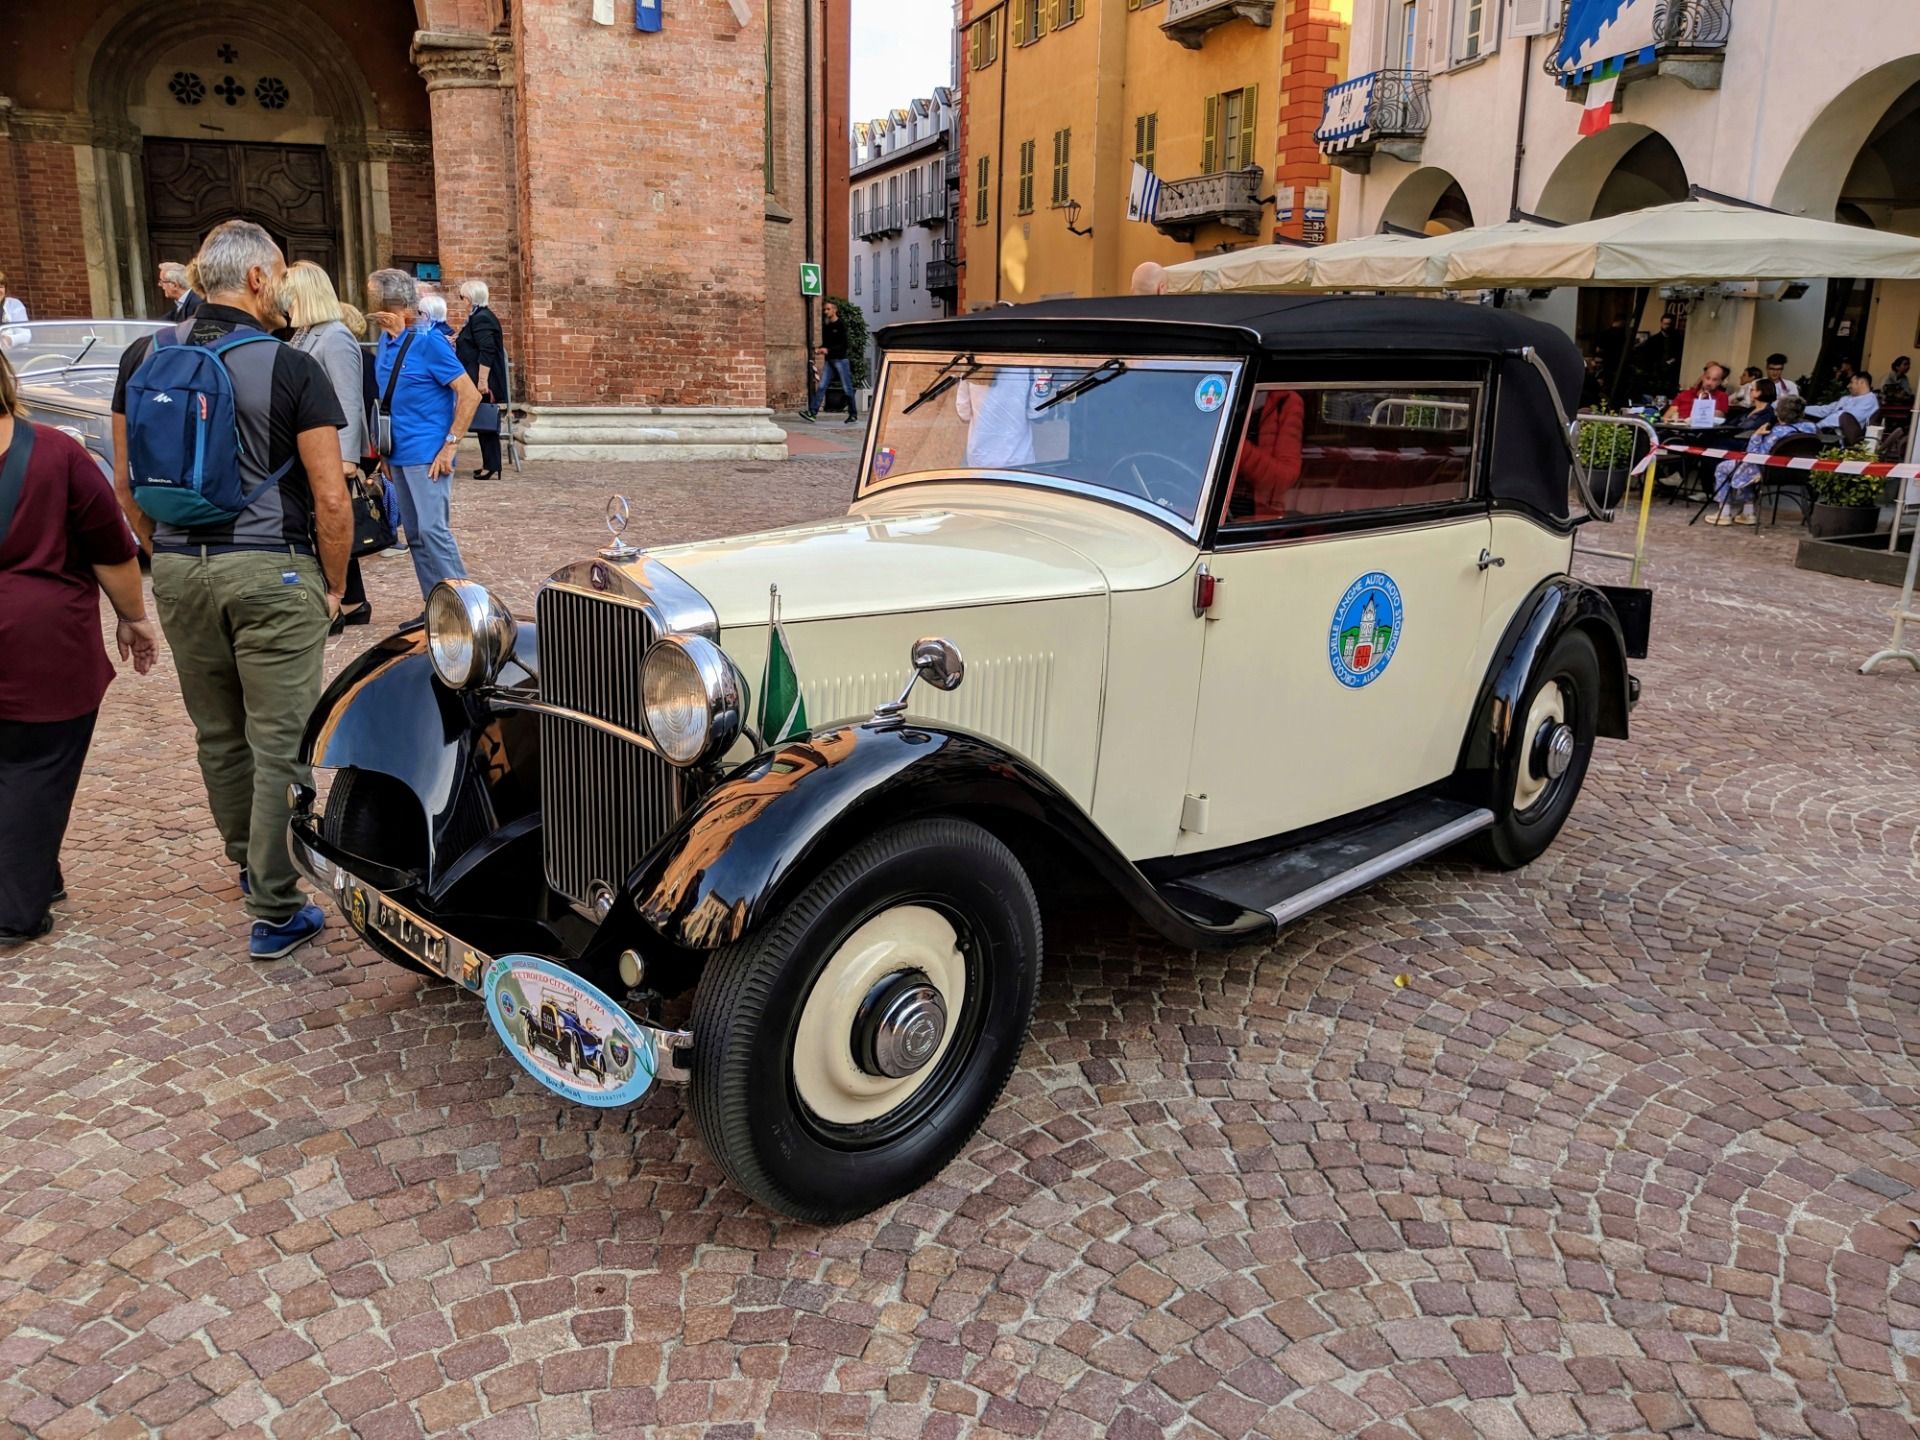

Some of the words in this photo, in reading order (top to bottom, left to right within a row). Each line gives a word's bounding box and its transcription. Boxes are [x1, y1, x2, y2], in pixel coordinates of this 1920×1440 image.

[1365, 575, 1385, 586] AUTO
[1336, 580, 1363, 621] LANGHE
[1385, 581, 1400, 607] MOTO
[1331, 625, 1340, 655] DELLE
[1384, 609, 1402, 660] STORICHE
[1362, 668, 1380, 685] ALBA
[584, 998, 605, 1016] ALBA
